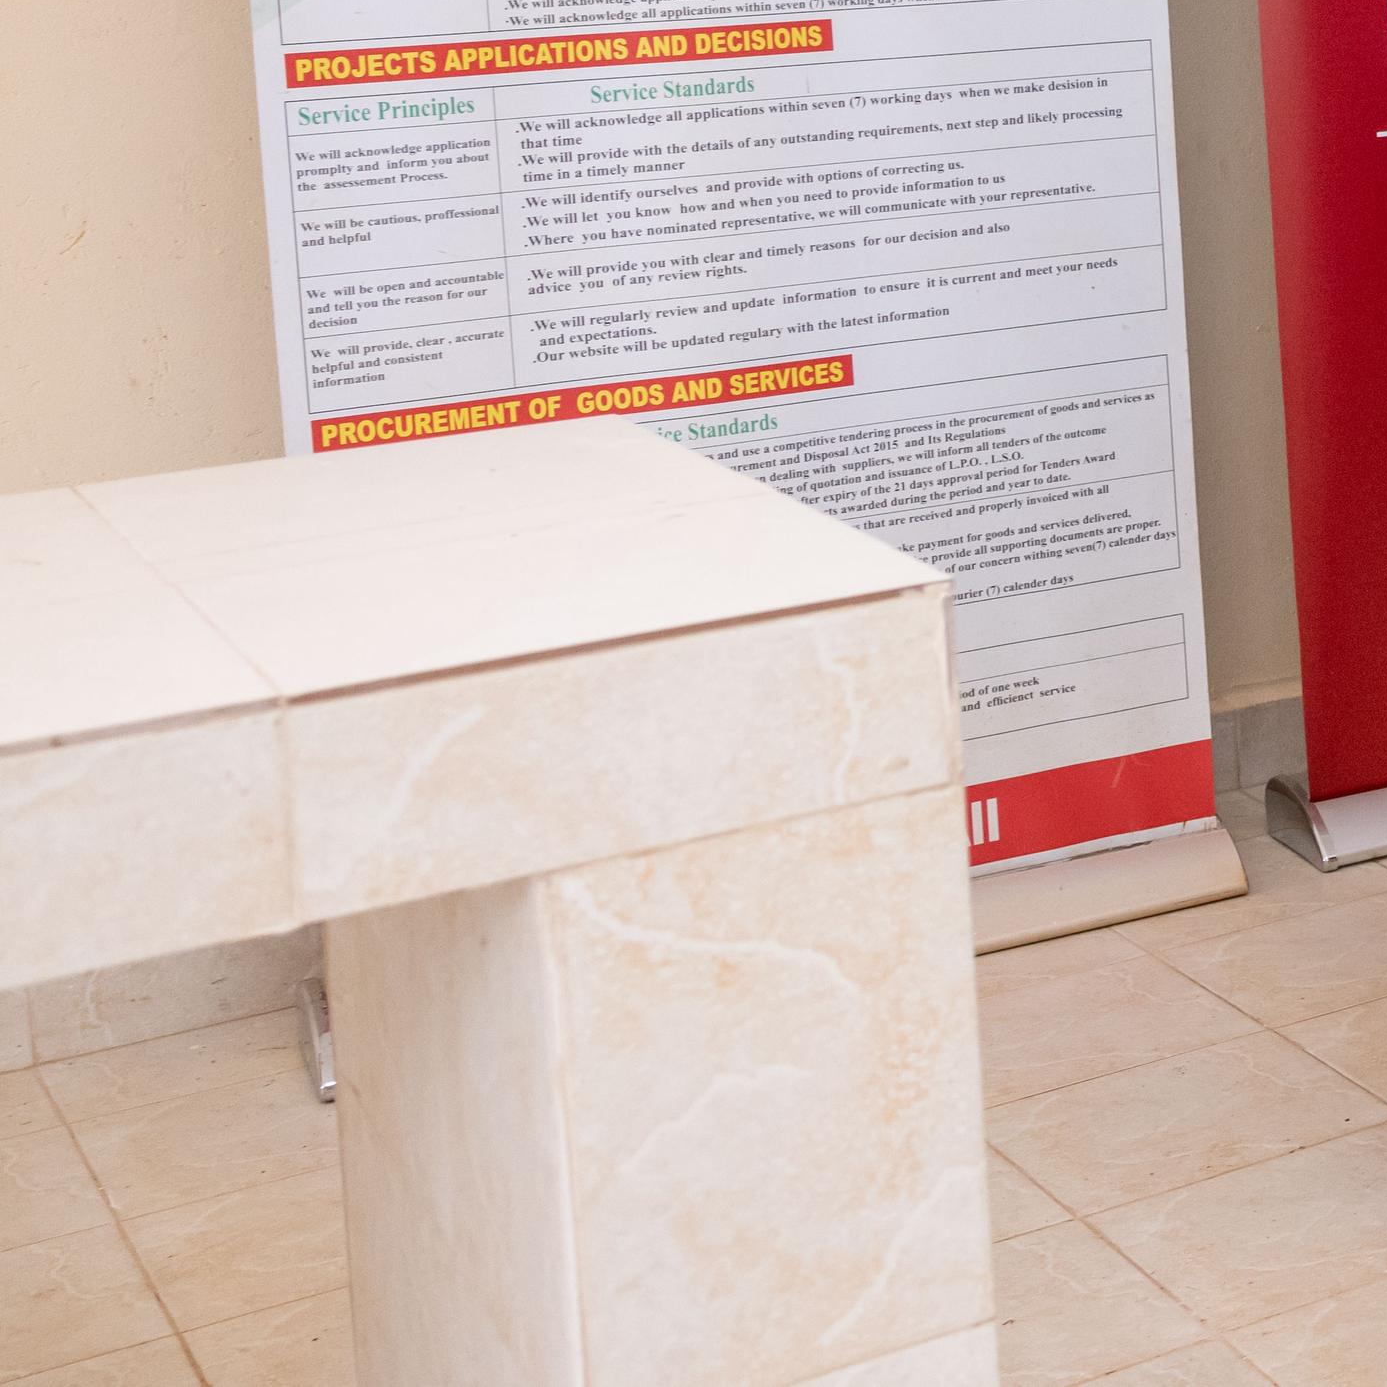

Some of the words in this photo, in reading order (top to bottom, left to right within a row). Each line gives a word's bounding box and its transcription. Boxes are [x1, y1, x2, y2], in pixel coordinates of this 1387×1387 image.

[295, 50, 436, 82] PROJECTS
[444, 38, 629, 72] APPLICATIONS
[635, 34, 688, 58] AND
[695, 25, 823, 55] DECISIONS
[590, 83, 658, 104] Service
[663, 75, 755, 99] Standards
[298, 104, 371, 126] Service
[377, 96, 475, 121] Principles
[551, 193, 576, 205] will
[580, 189, 632, 203] identify
[636, 184, 698, 199] ourselves
[706, 180, 730, 193] and
[734, 176, 783, 193] provide
[786, 173, 814, 184] with
[817, 169, 863, 184] options
[866, 166, 879, 178] of
[882, 162, 945, 176] correcting
[948, 161, 964, 170] us.
[321, 400, 521, 447] PROCUREMENT
[528, 395, 561, 420] OF
[577, 384, 665, 414] GOODS
[672, 377, 723, 403] AND
[730, 361, 844, 396] SERVICES
[687, 413, 779, 439] Standards
[717, 448, 739, 460] and
[742, 448, 760, 457] use
[763, 446, 770, 454] a
[773, 436, 836, 452] competitive
[839, 428, 891, 443] tendering
[893, 423, 933, 438] process
[936, 420, 946, 430] in
[949, 417, 966, 428] the
[968, 408, 1034, 428] procurement
[1037, 405, 1048, 416] of
[1050, 402, 1080, 416] goods
[1082, 398, 1101, 409] and
[1103, 394, 1142, 407] services
[1144, 393, 1155, 401] as
[961, 700, 981, 712] and
[1039, 684, 1076, 698] service
